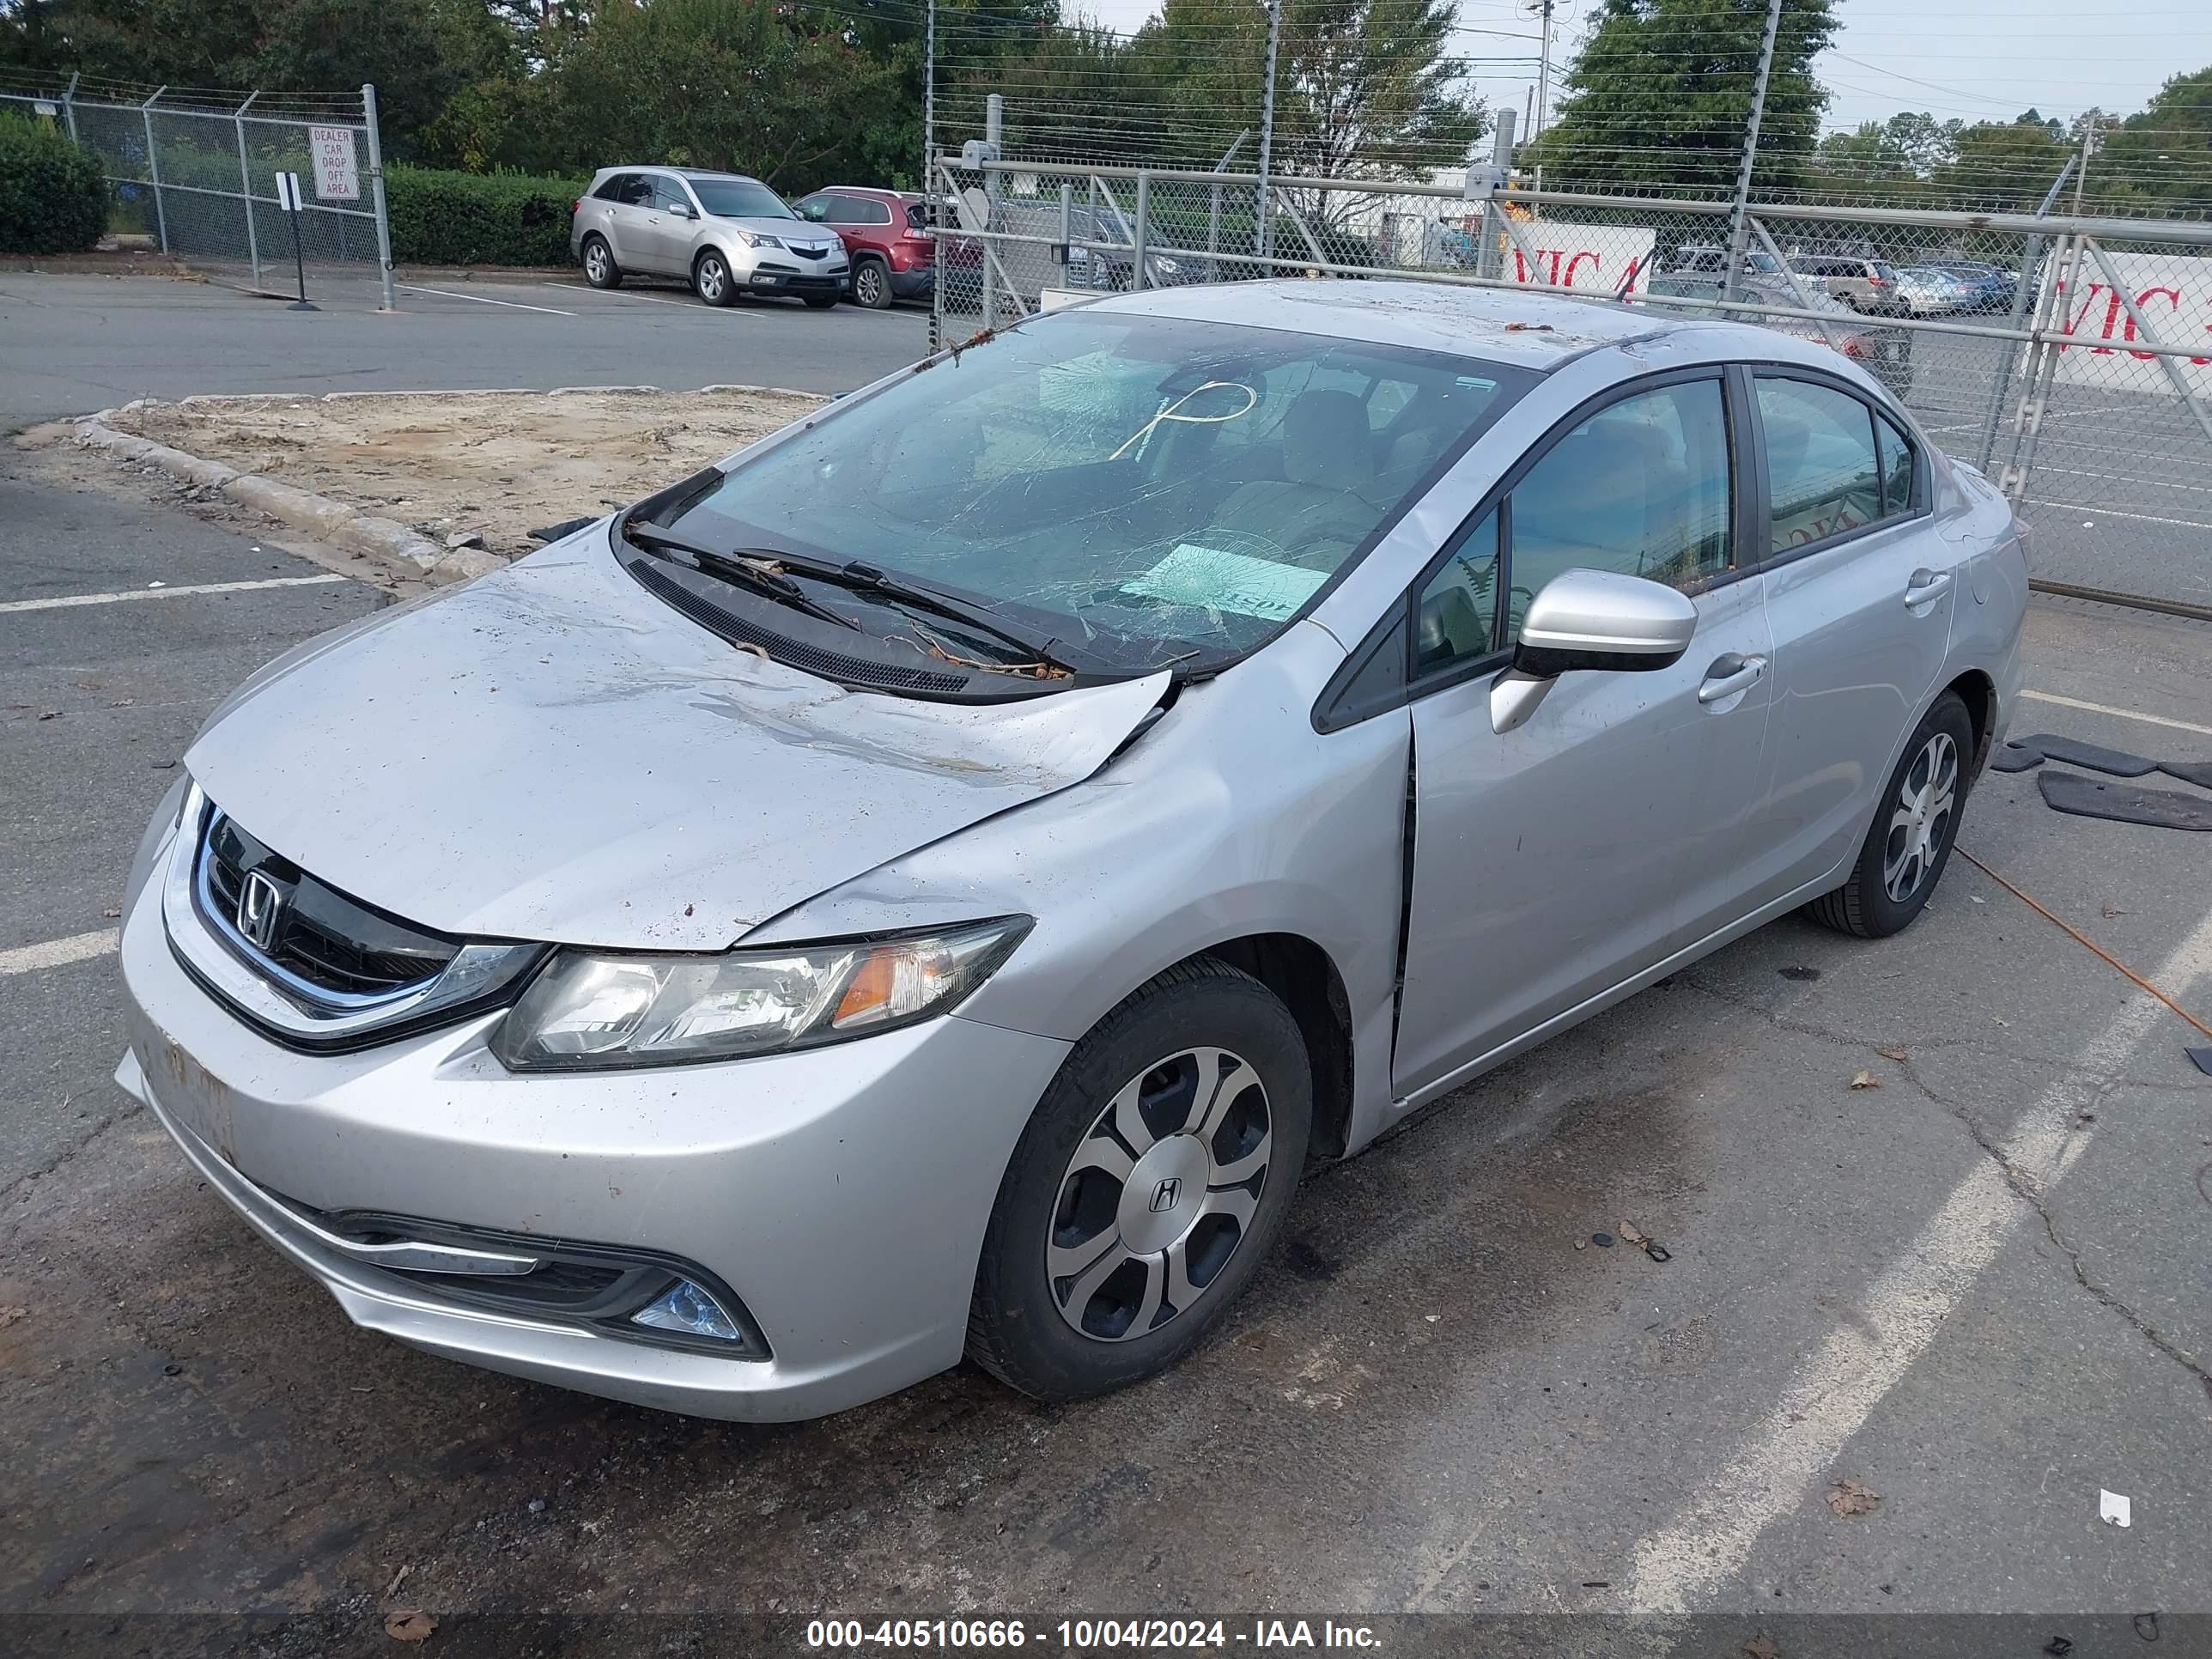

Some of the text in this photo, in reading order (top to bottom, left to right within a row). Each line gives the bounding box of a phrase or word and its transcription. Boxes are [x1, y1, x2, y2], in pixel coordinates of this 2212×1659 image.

[314, 131, 349, 141] DEALER
[324, 144, 343, 155] CAR
[322, 157, 347, 167] DROP
[328, 171, 344, 182] OFF
[326, 184, 349, 194] AREA
